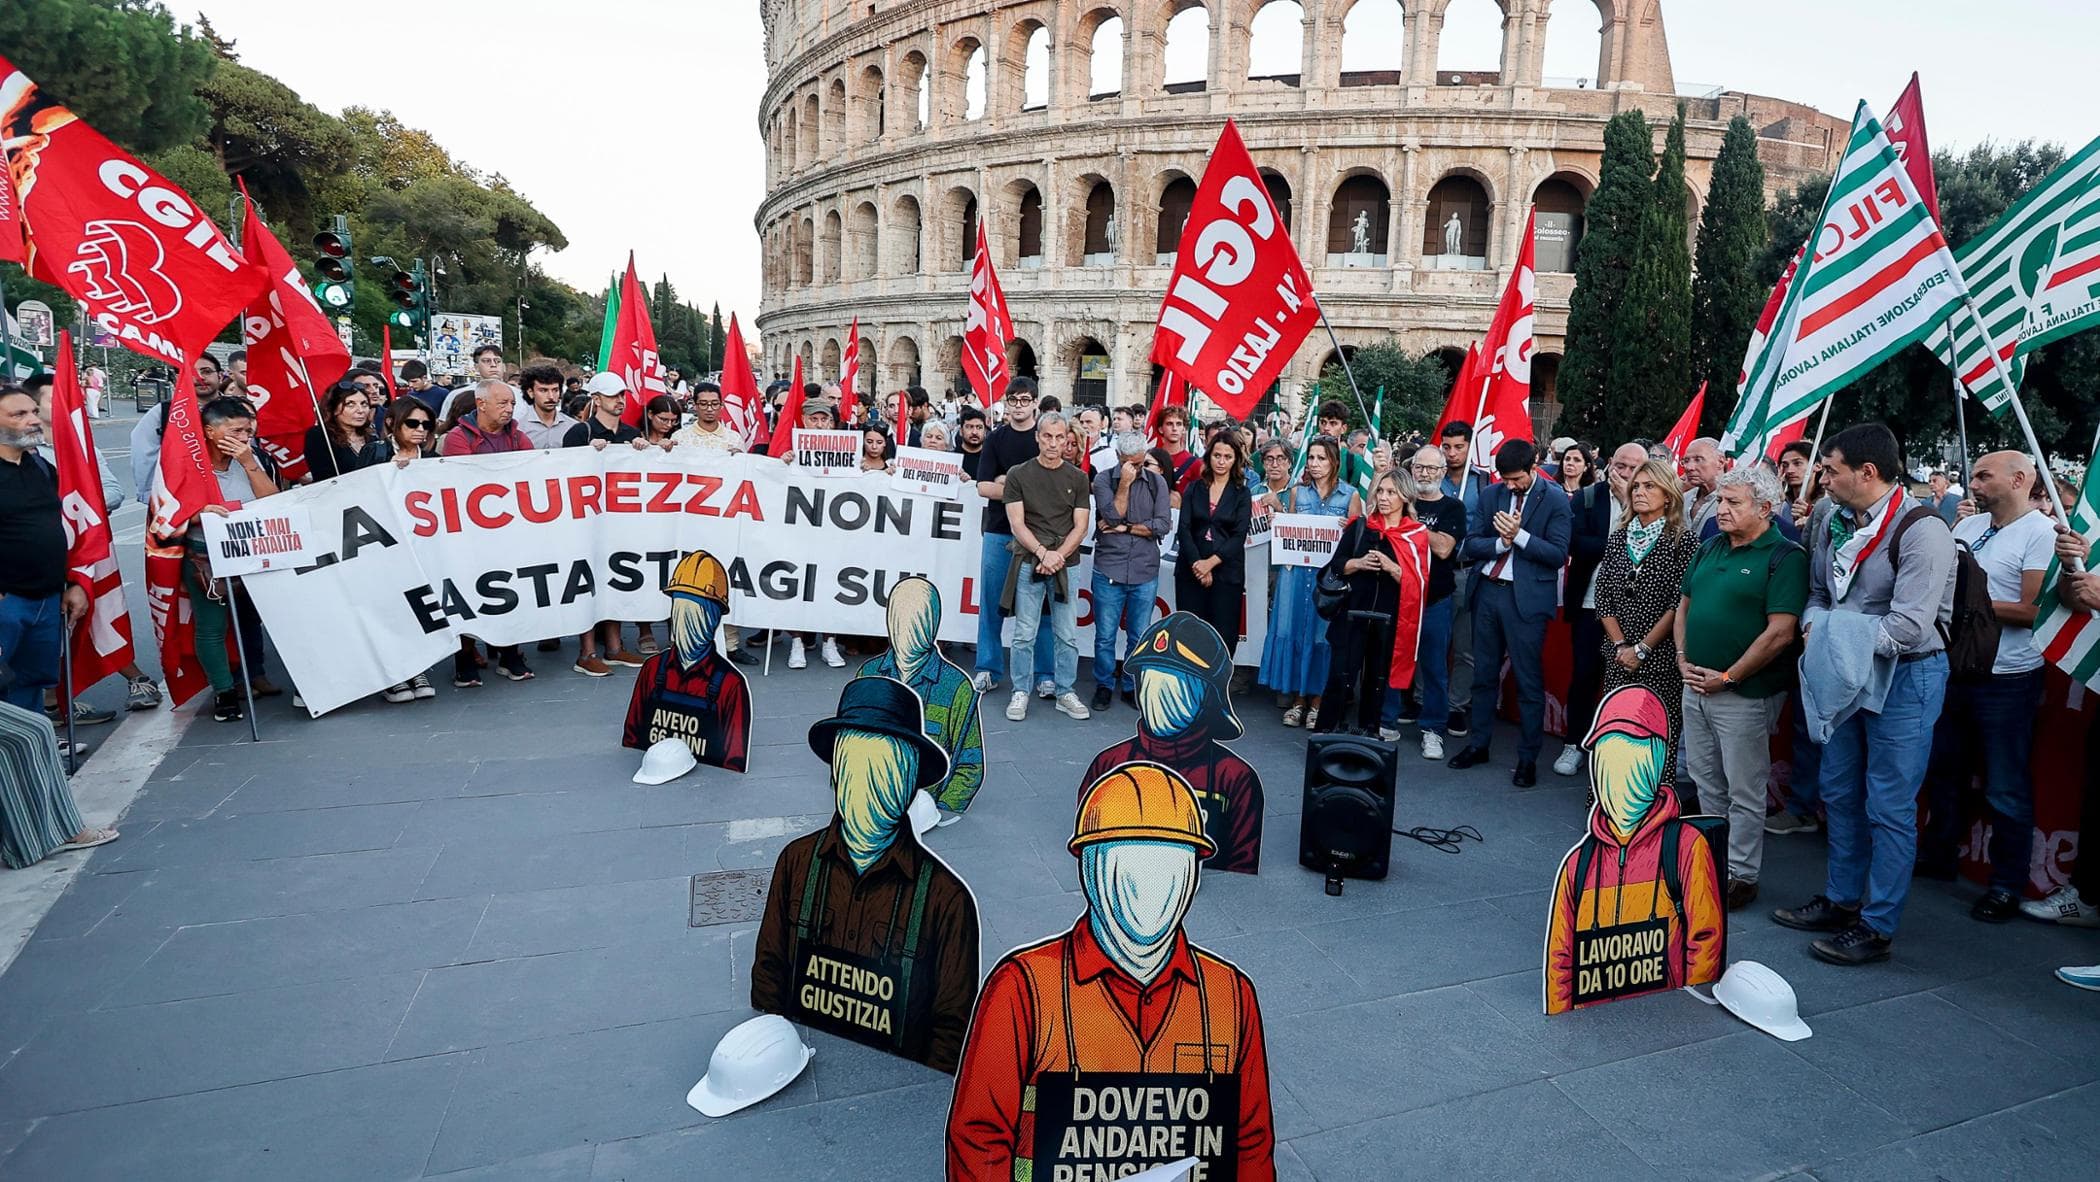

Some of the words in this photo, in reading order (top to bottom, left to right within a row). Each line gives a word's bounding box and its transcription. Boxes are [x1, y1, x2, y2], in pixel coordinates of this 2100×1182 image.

[98, 159, 240, 272] CGIL
[797, 434, 857, 451] FERMIAMO
[799, 450, 812, 467] LA
[814, 450, 855, 467] STRAGE
[897, 455, 935, 473] L'UMANITÀ
[935, 462, 960, 476] PRIMA
[902, 468, 915, 480] DEL
[916, 470, 949, 485] PROFITTO
[404, 472, 765, 537] SICUREZZA
[784, 486, 913, 536] NON
[225, 520, 256, 540] NON
[256, 517, 264, 537] È
[264, 517, 291, 536] MAI
[1274, 524, 1314, 539] L'UMANITÀ
[1314, 528, 1340, 543] PRIMA
[221, 540, 250, 558] UNA
[251, 531, 303, 556] FATALITÀ
[1282, 537, 1296, 550] DEL
[1296, 539, 1332, 554] PROFITTO
[607, 550, 818, 602] STAGI
[834, 566, 928, 608] SU
[651, 708, 699, 735] AVEVO
[1579, 928, 1665, 966] LAVORAVO
[806, 954, 894, 1001] ATTENDO
[1578, 967, 1602, 995] DA
[1605, 963, 1626, 989] 10
[1630, 956, 1664, 985] ORE
[800, 984, 892, 1035] GIUSTIZIA
[1073, 1087, 1210, 1121] DOVEVO
[1058, 1125, 1187, 1158] ANDARE
[1194, 1125, 1223, 1157] IN
